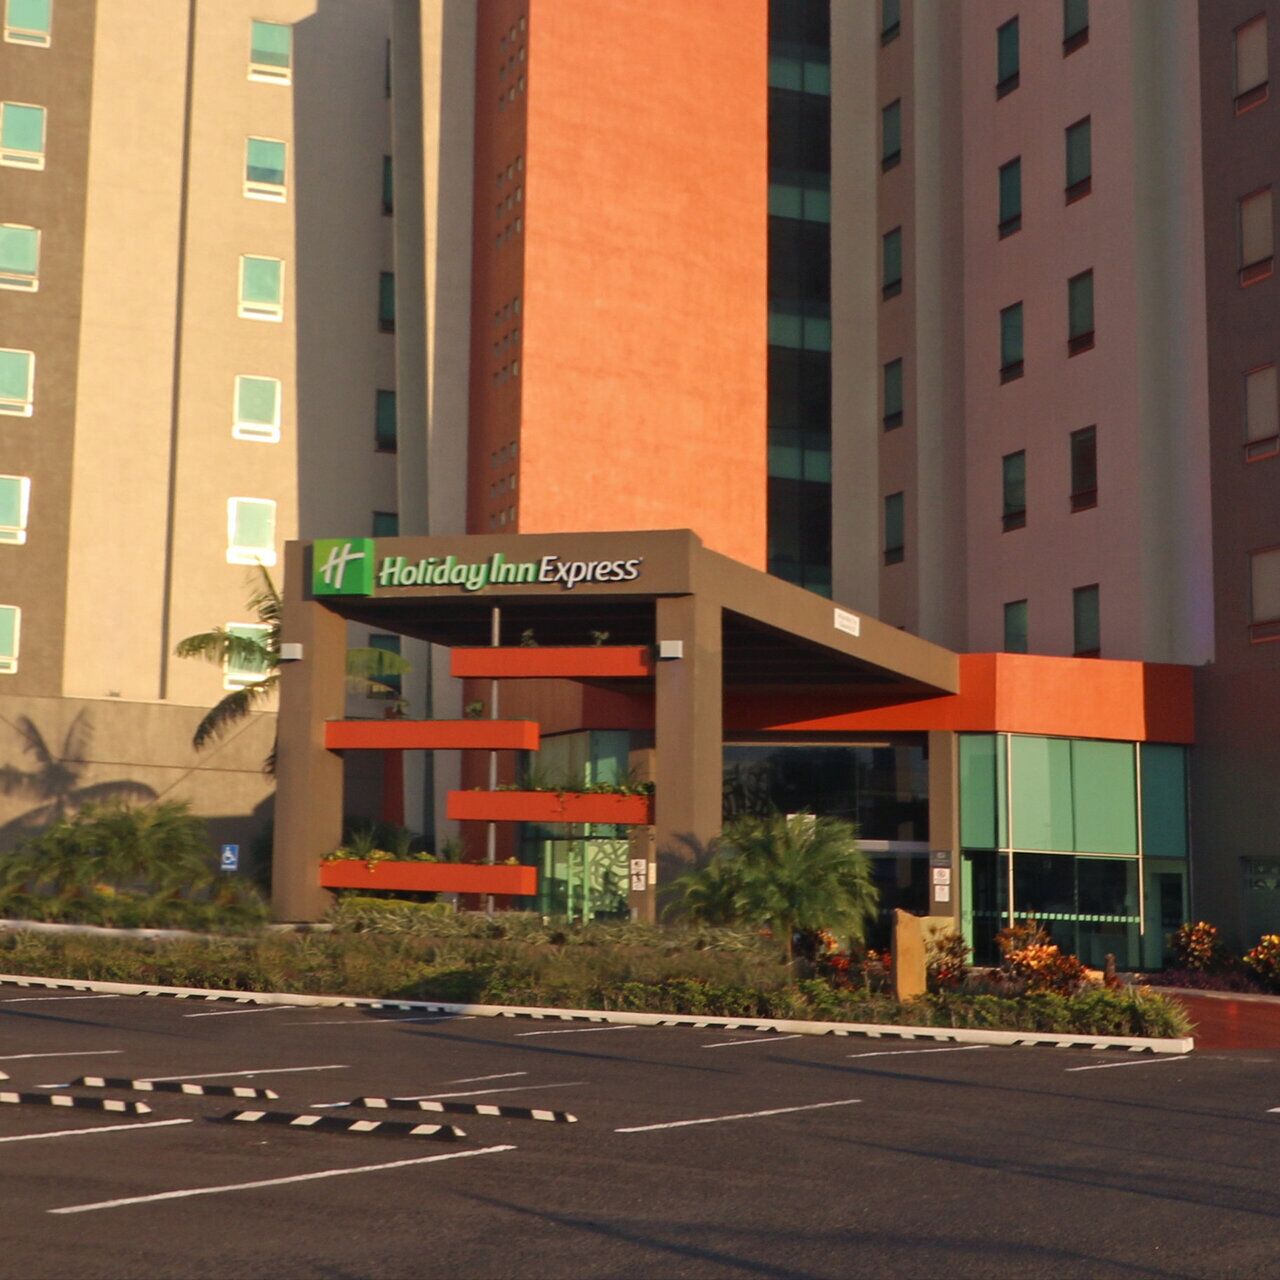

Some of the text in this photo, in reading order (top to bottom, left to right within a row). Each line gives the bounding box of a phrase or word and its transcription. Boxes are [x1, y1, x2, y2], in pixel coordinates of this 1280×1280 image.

[380, 553, 639, 590] Holiday Inn Express
